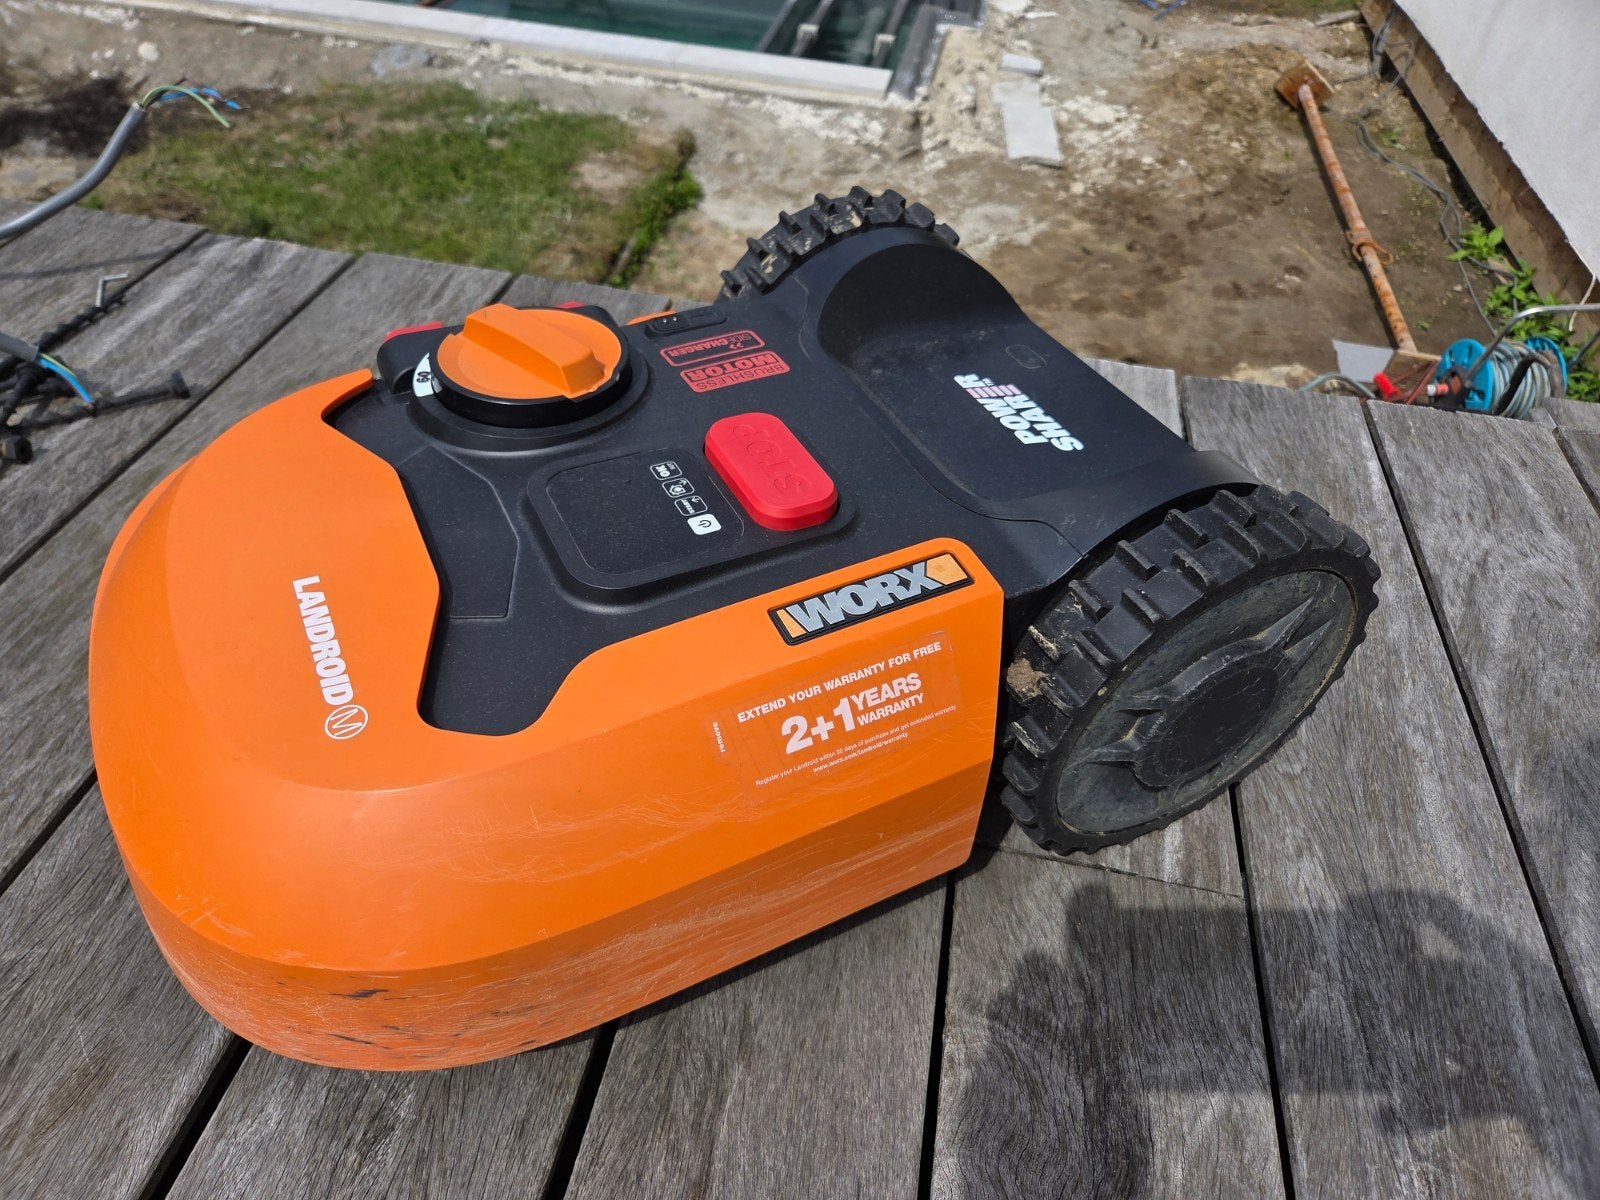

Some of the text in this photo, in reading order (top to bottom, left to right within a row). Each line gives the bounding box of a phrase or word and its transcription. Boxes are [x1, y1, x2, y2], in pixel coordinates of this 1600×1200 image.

[668, 338, 729, 357] CHARGER
[685, 353, 777, 382] MOTOR
[696, 364, 784, 391] BRUSHLESS
[655, 464, 671, 477] OK
[732, 424, 812, 493] STOP
[785, 561, 944, 633] WORX
[293, 575, 354, 706] LANDROID
[737, 641, 942, 723] EXTEND YOUR WARRANTY FOR FREE
[781, 672, 922, 755] 2+1 YEARS
[857, 693, 924, 727] WARRANTY
[712, 721, 725, 753] remove
[755, 773, 779, 786] Register
[780, 769, 793, 779] your
[793, 758, 818, 772] Landroid
[819, 753, 836, 764] within
[844, 744, 857, 753] days
[864, 731, 889, 745] purchase
[890, 726, 900, 734] and
[900, 722, 910, 732] get
[910, 714, 934, 727] extended
[934, 705, 957, 718] warranty
[812, 732, 908, 773] www.worx.com/landroid/warranty
